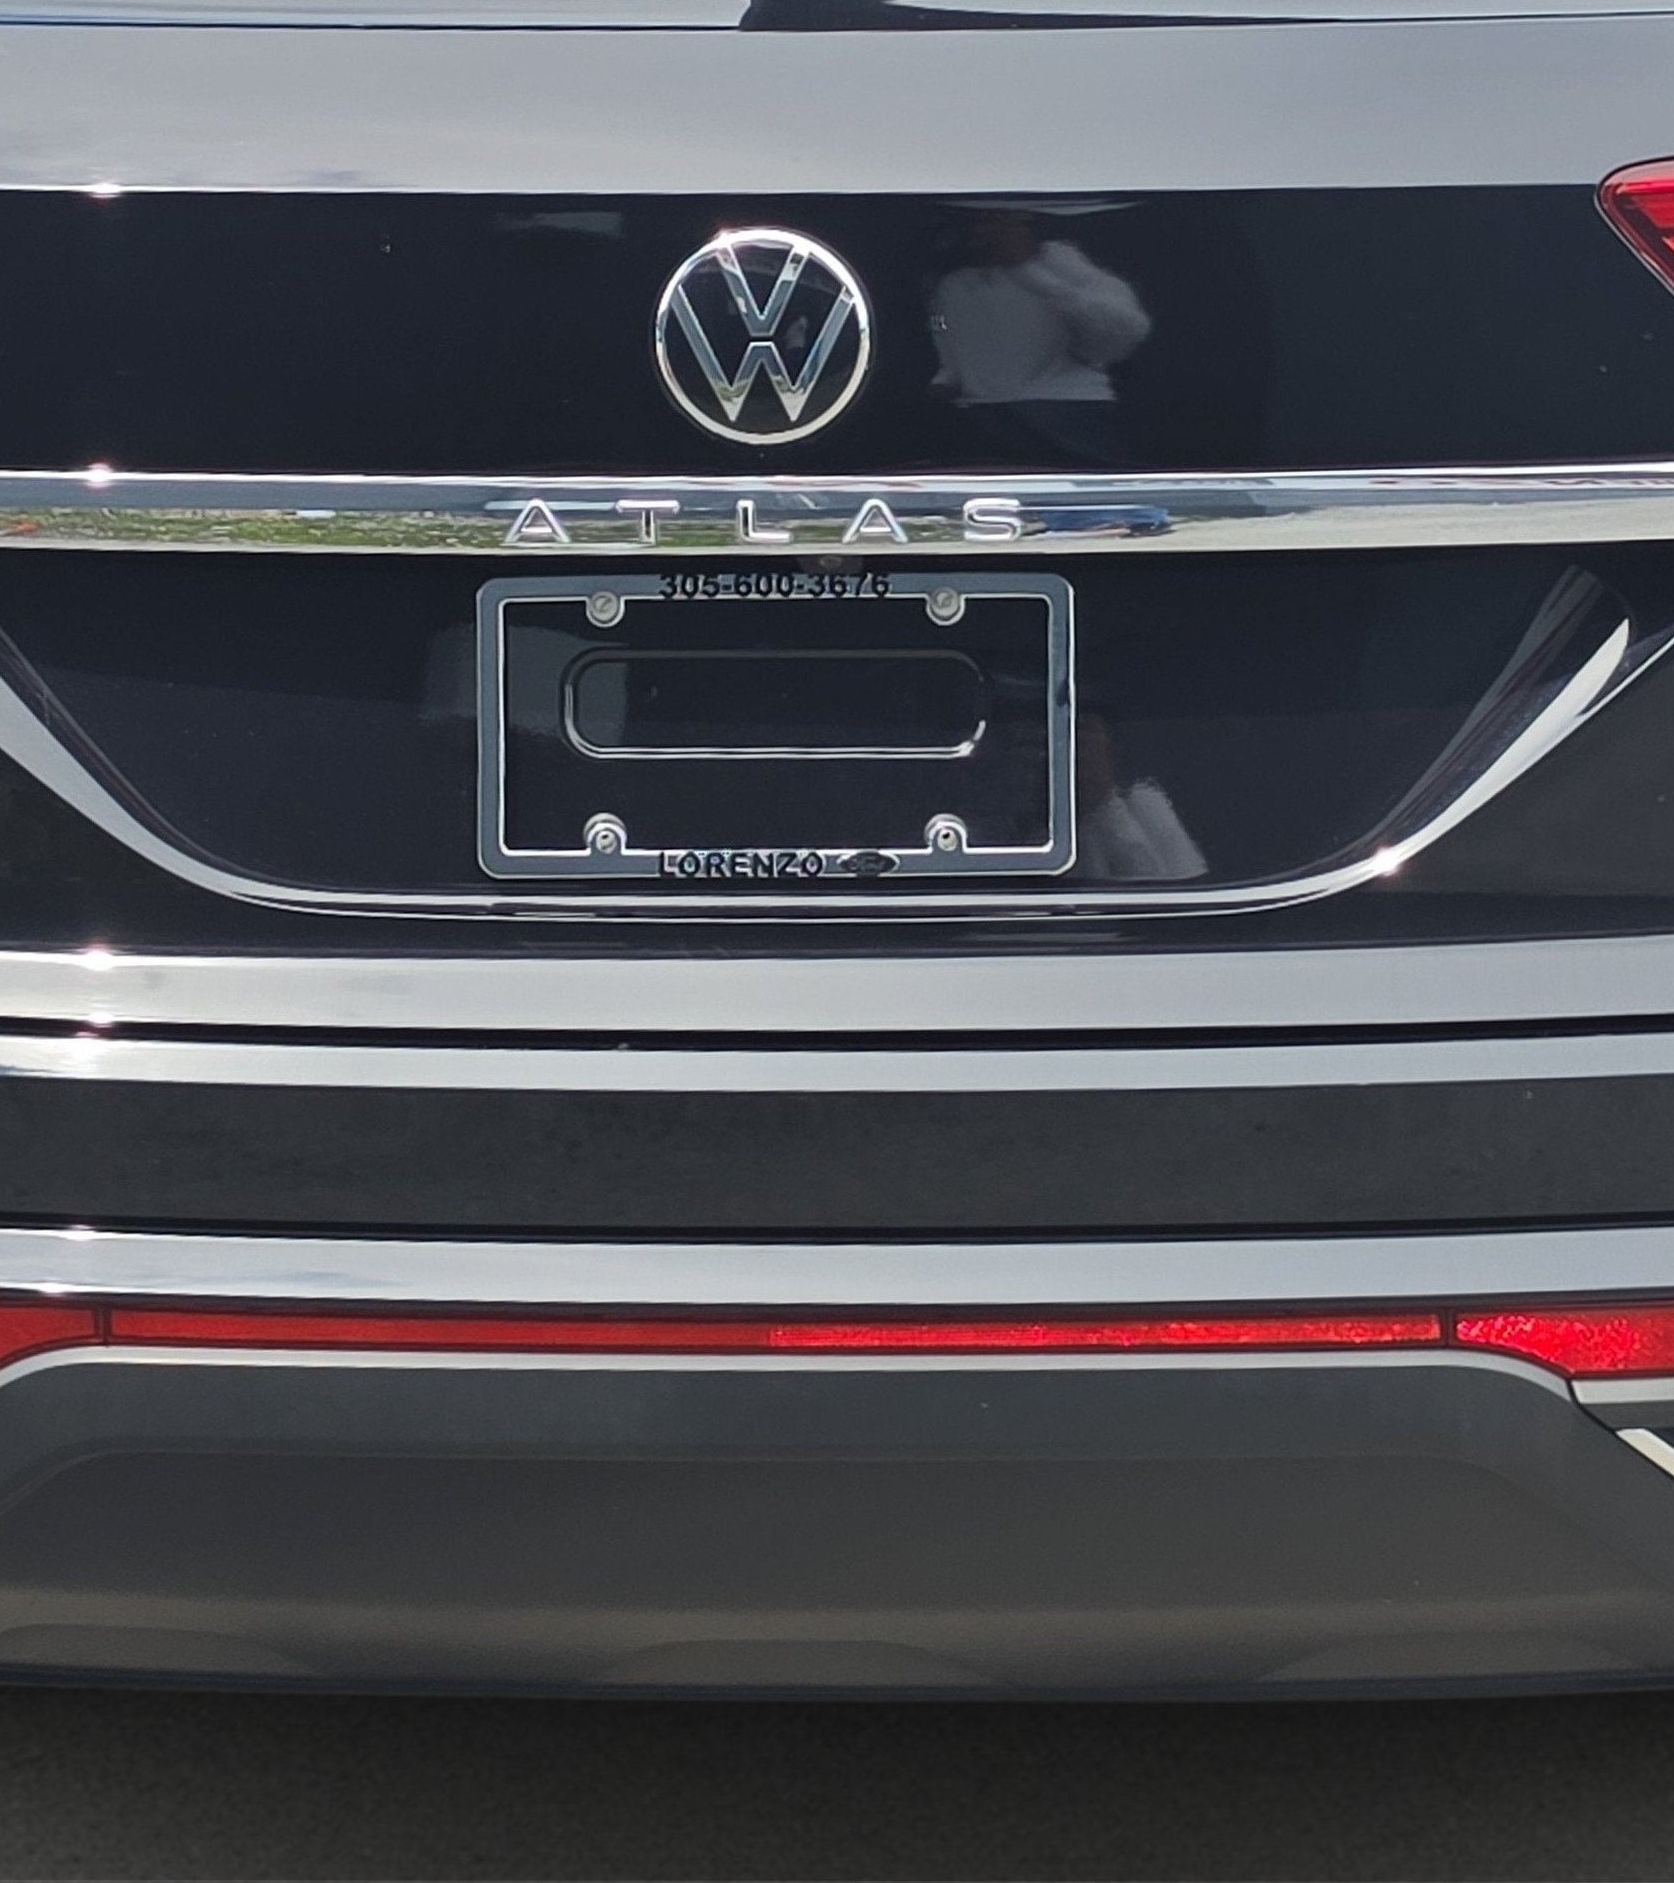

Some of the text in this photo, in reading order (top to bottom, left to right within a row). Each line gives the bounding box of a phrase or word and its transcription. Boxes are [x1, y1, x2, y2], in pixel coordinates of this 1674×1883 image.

[502, 498, 1023, 544] ATLAS
[659, 573, 890, 599] 305-600-3676
[659, 850, 824, 877] LORENZO
